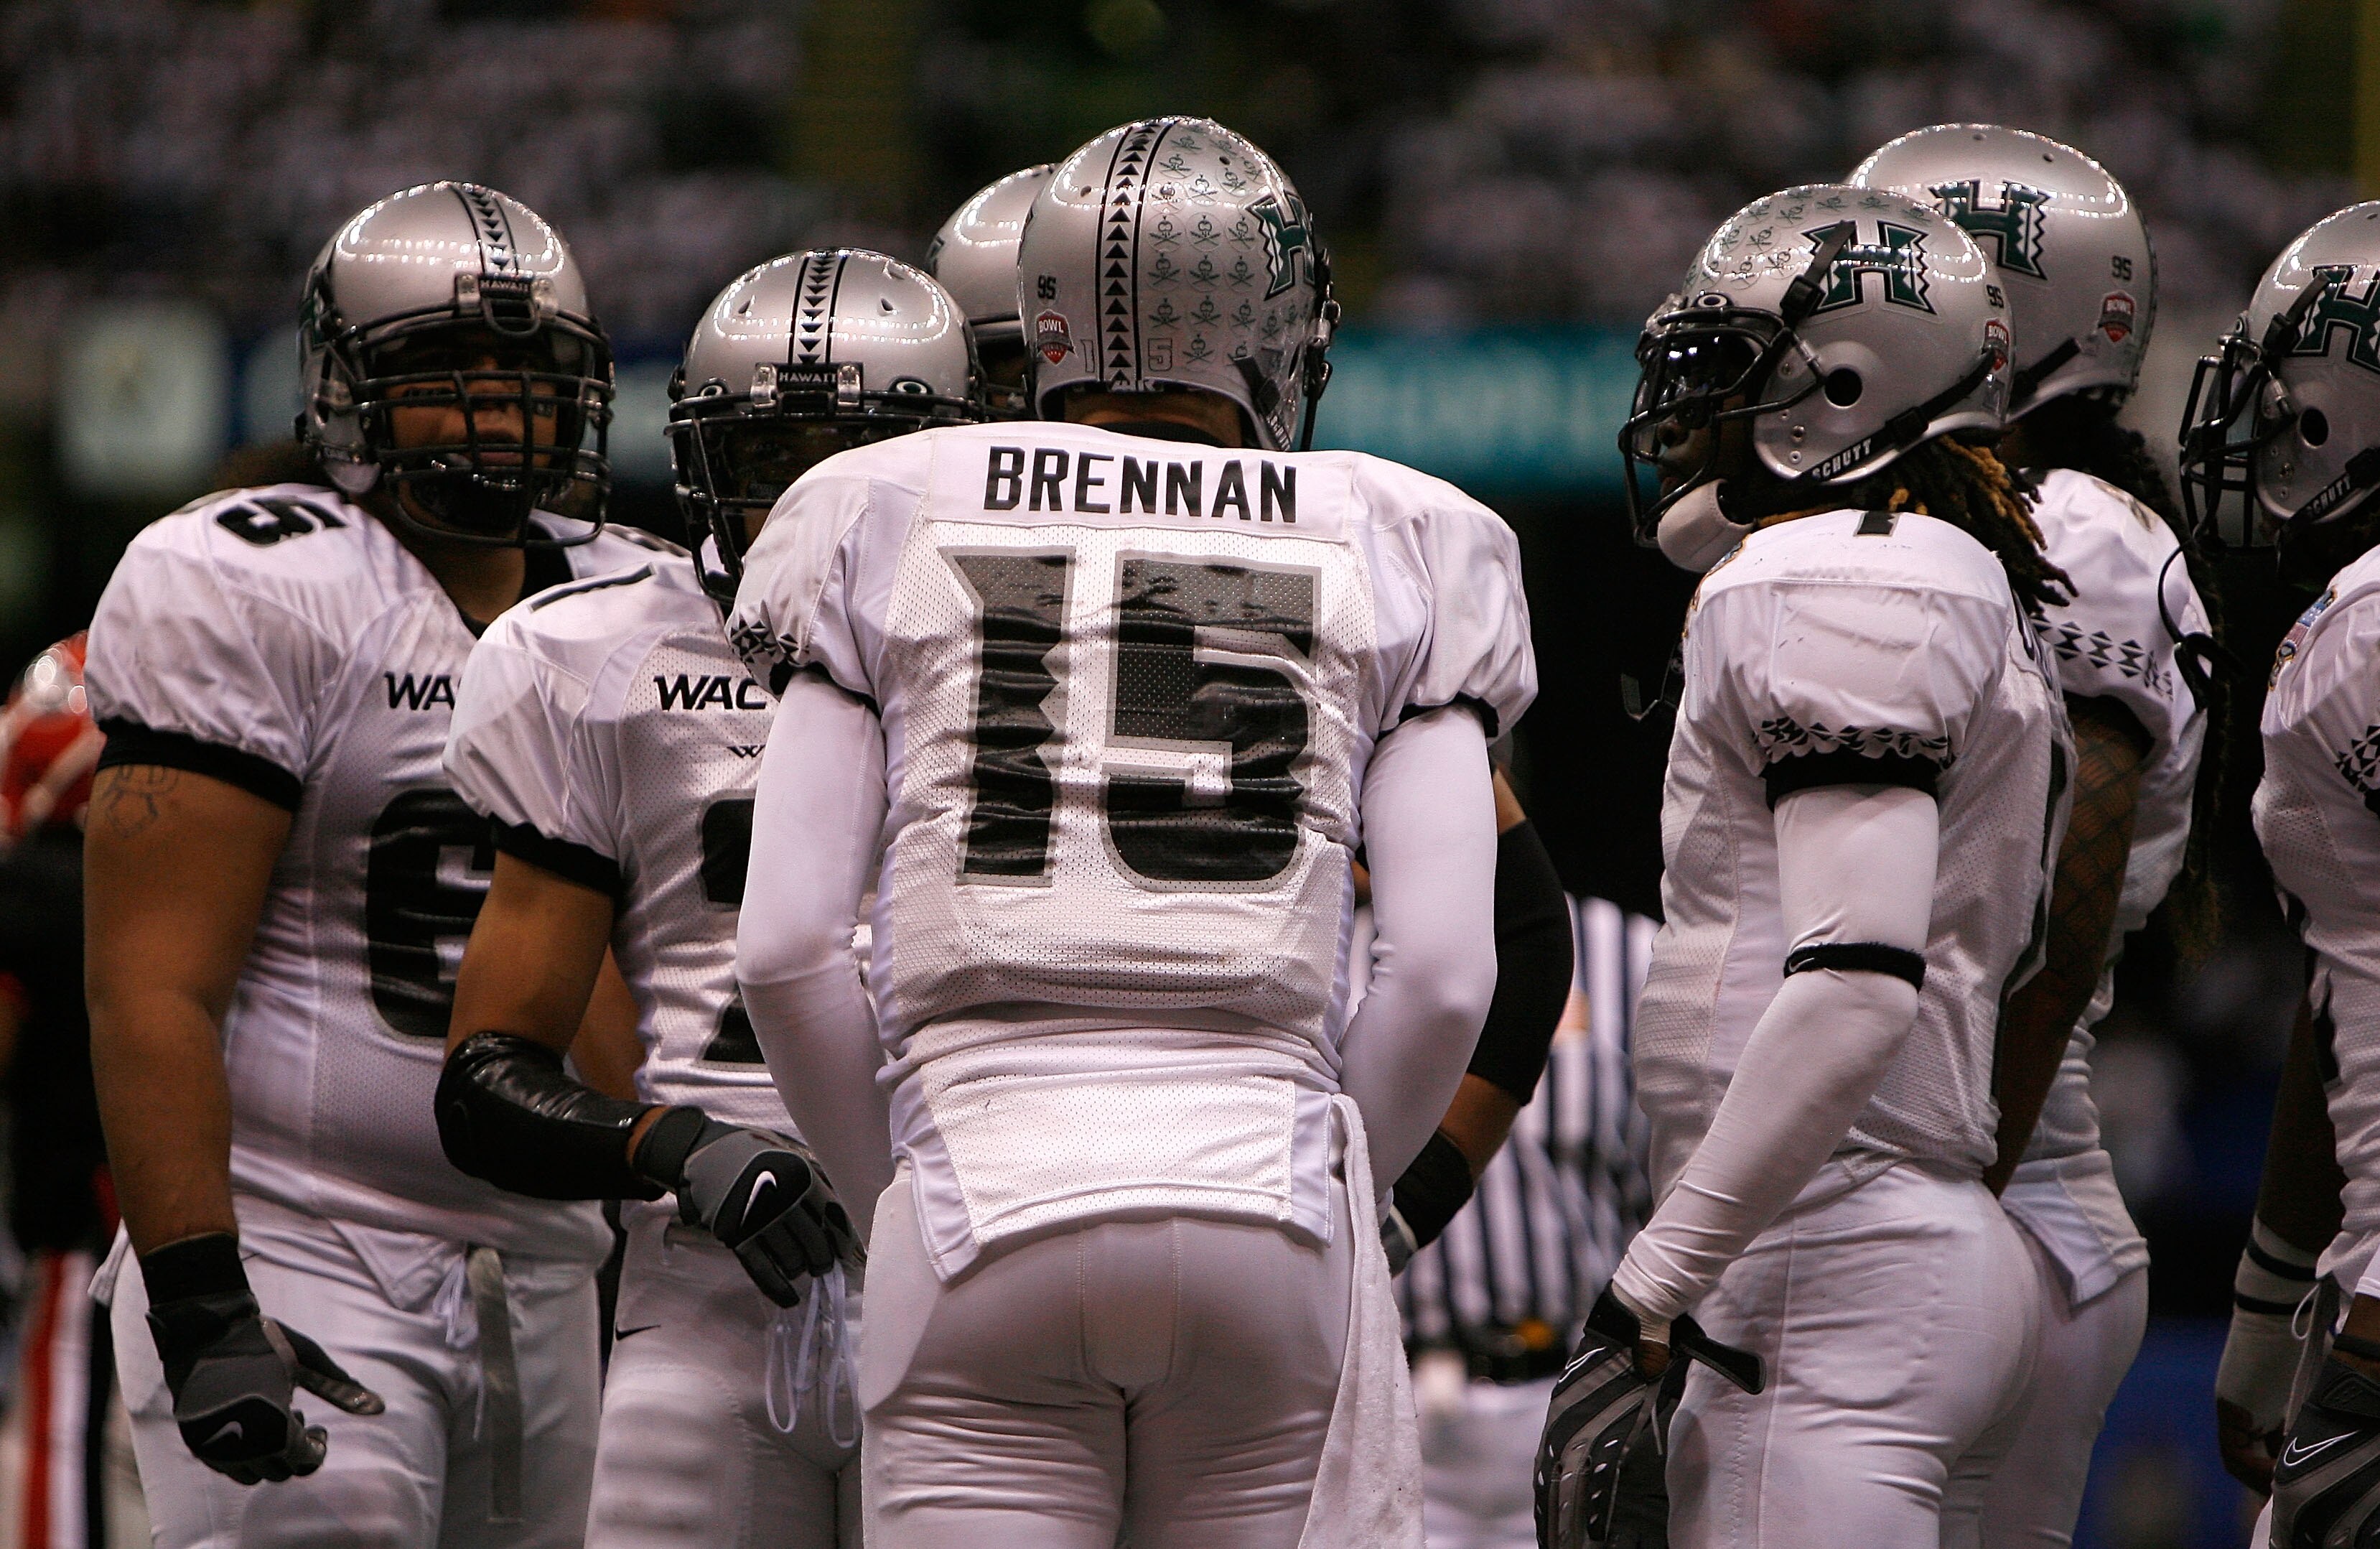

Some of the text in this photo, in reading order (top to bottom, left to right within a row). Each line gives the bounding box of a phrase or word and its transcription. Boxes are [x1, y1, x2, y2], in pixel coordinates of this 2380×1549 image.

[1038, 319, 1064, 333] BOWL
[778, 372, 837, 383] HAWAII
[1811, 437, 1872, 479] SCHUTT
[983, 445, 1297, 524] BRENNAN
[383, 670, 461, 711] WA
[653, 674, 767, 712] WAC
[936, 544, 1322, 895] 15
